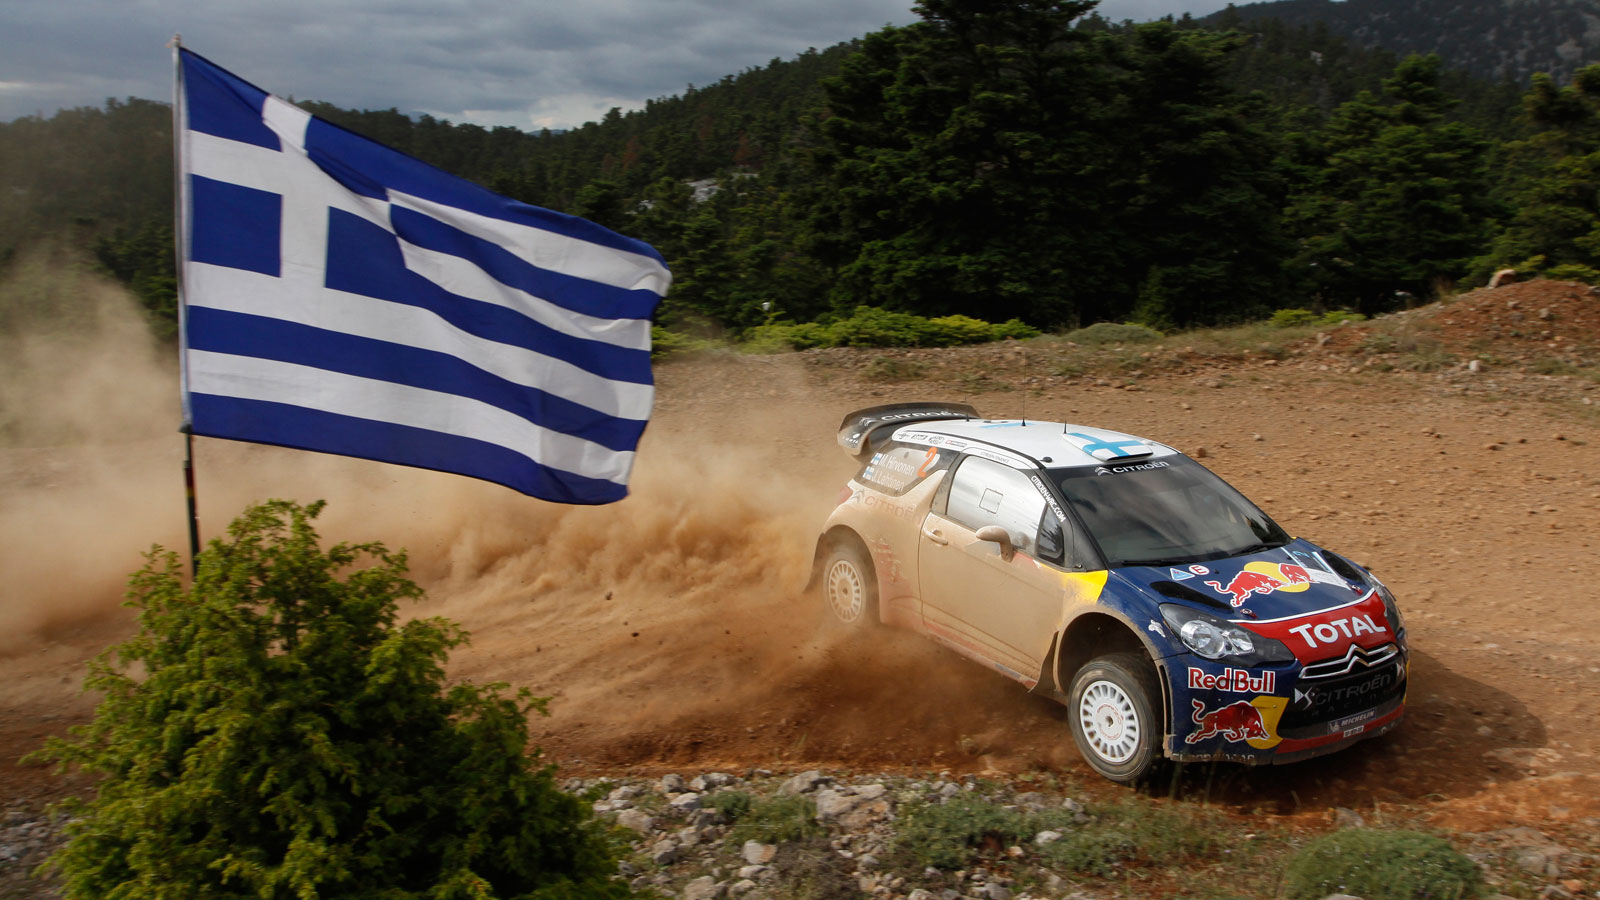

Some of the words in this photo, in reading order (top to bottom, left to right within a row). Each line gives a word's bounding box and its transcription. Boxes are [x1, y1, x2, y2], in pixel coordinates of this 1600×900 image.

[886, 455, 915, 477] Hirvonen
[917, 446, 938, 479] 2
[1112, 460, 1170, 476] CITROËN
[877, 472, 905, 492] Lehtinen
[1288, 613, 1387, 649] TOTAL
[1341, 710, 1376, 726] MICHELIN
